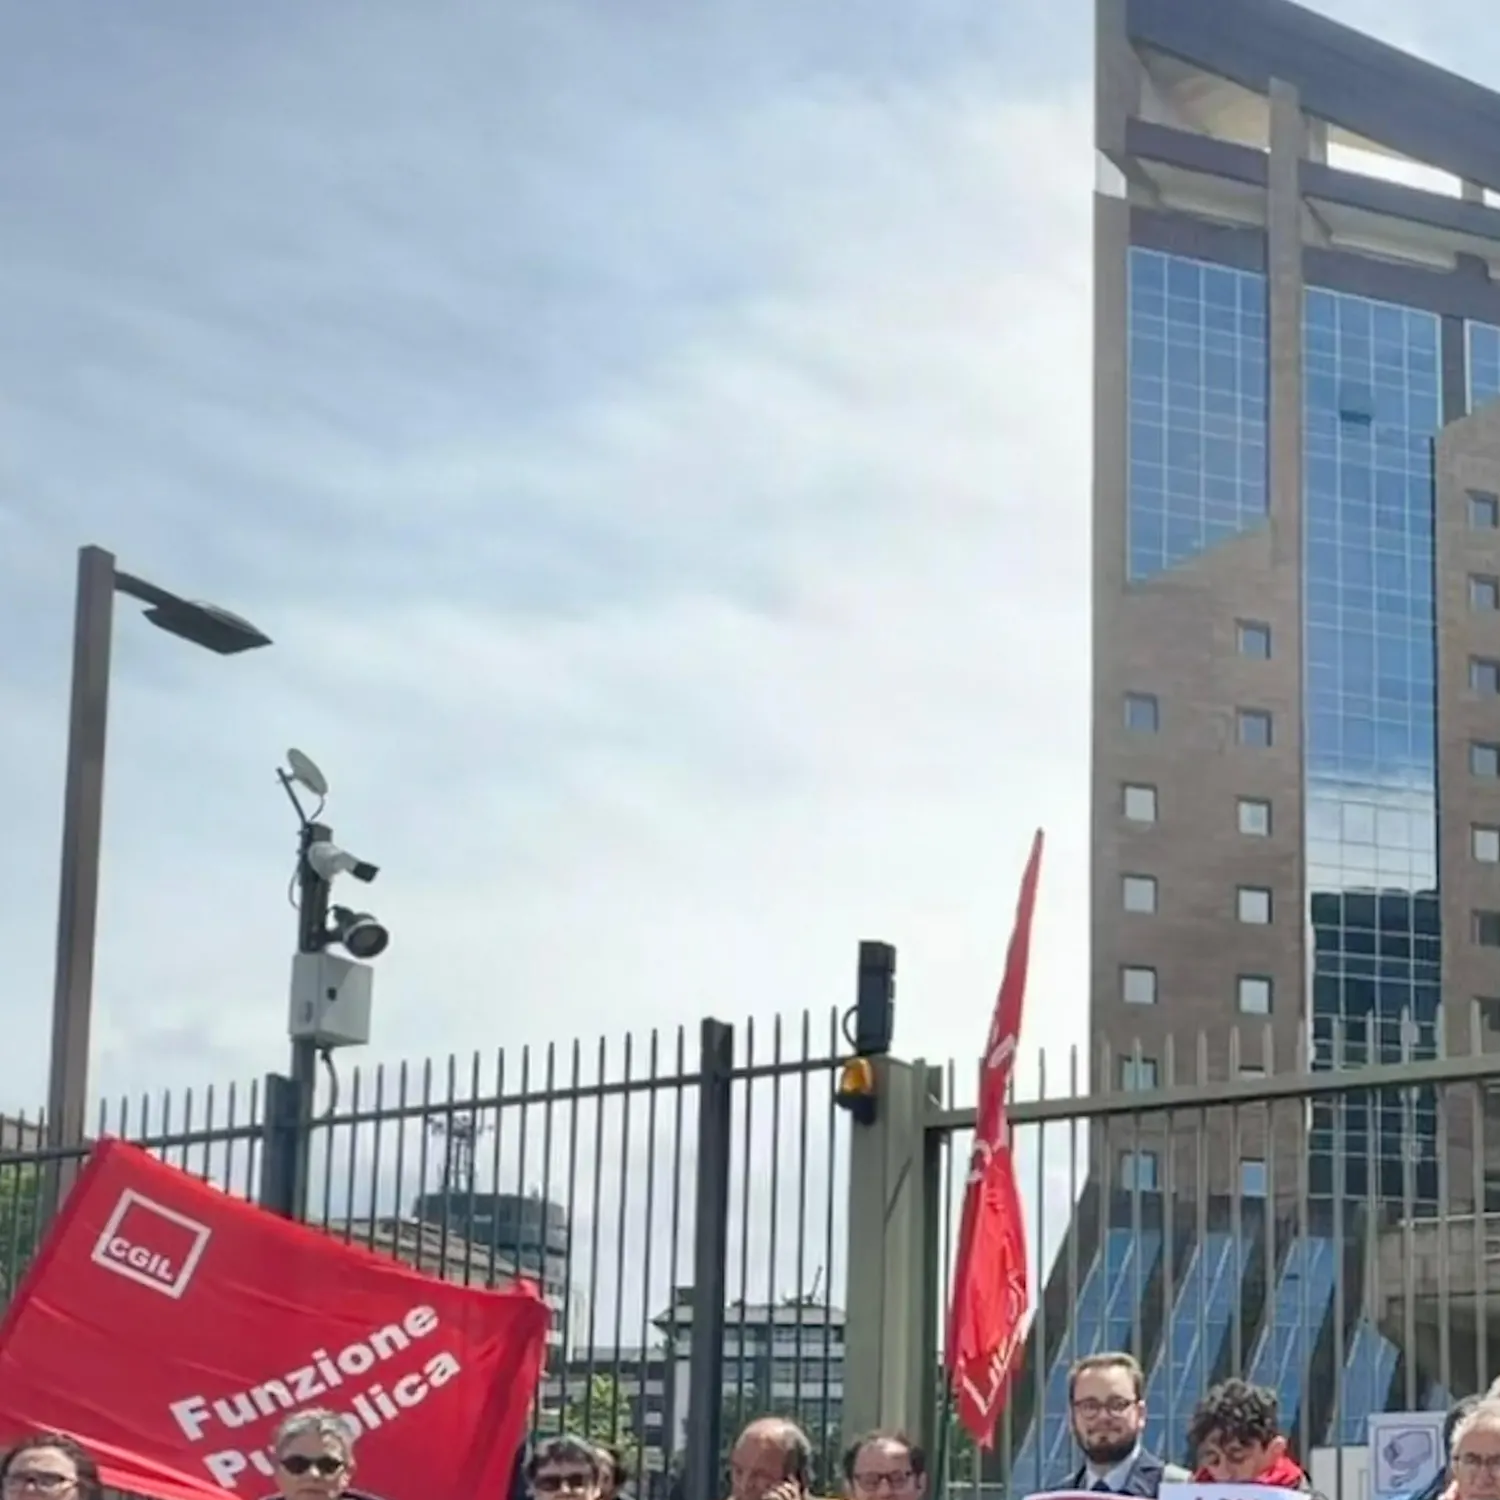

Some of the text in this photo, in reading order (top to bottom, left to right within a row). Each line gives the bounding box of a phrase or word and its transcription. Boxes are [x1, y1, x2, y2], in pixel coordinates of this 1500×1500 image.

[107, 1236, 174, 1282] CGIL
[169, 1303, 440, 1441] Funzione
[202, 1350, 462, 1489] Pulica
